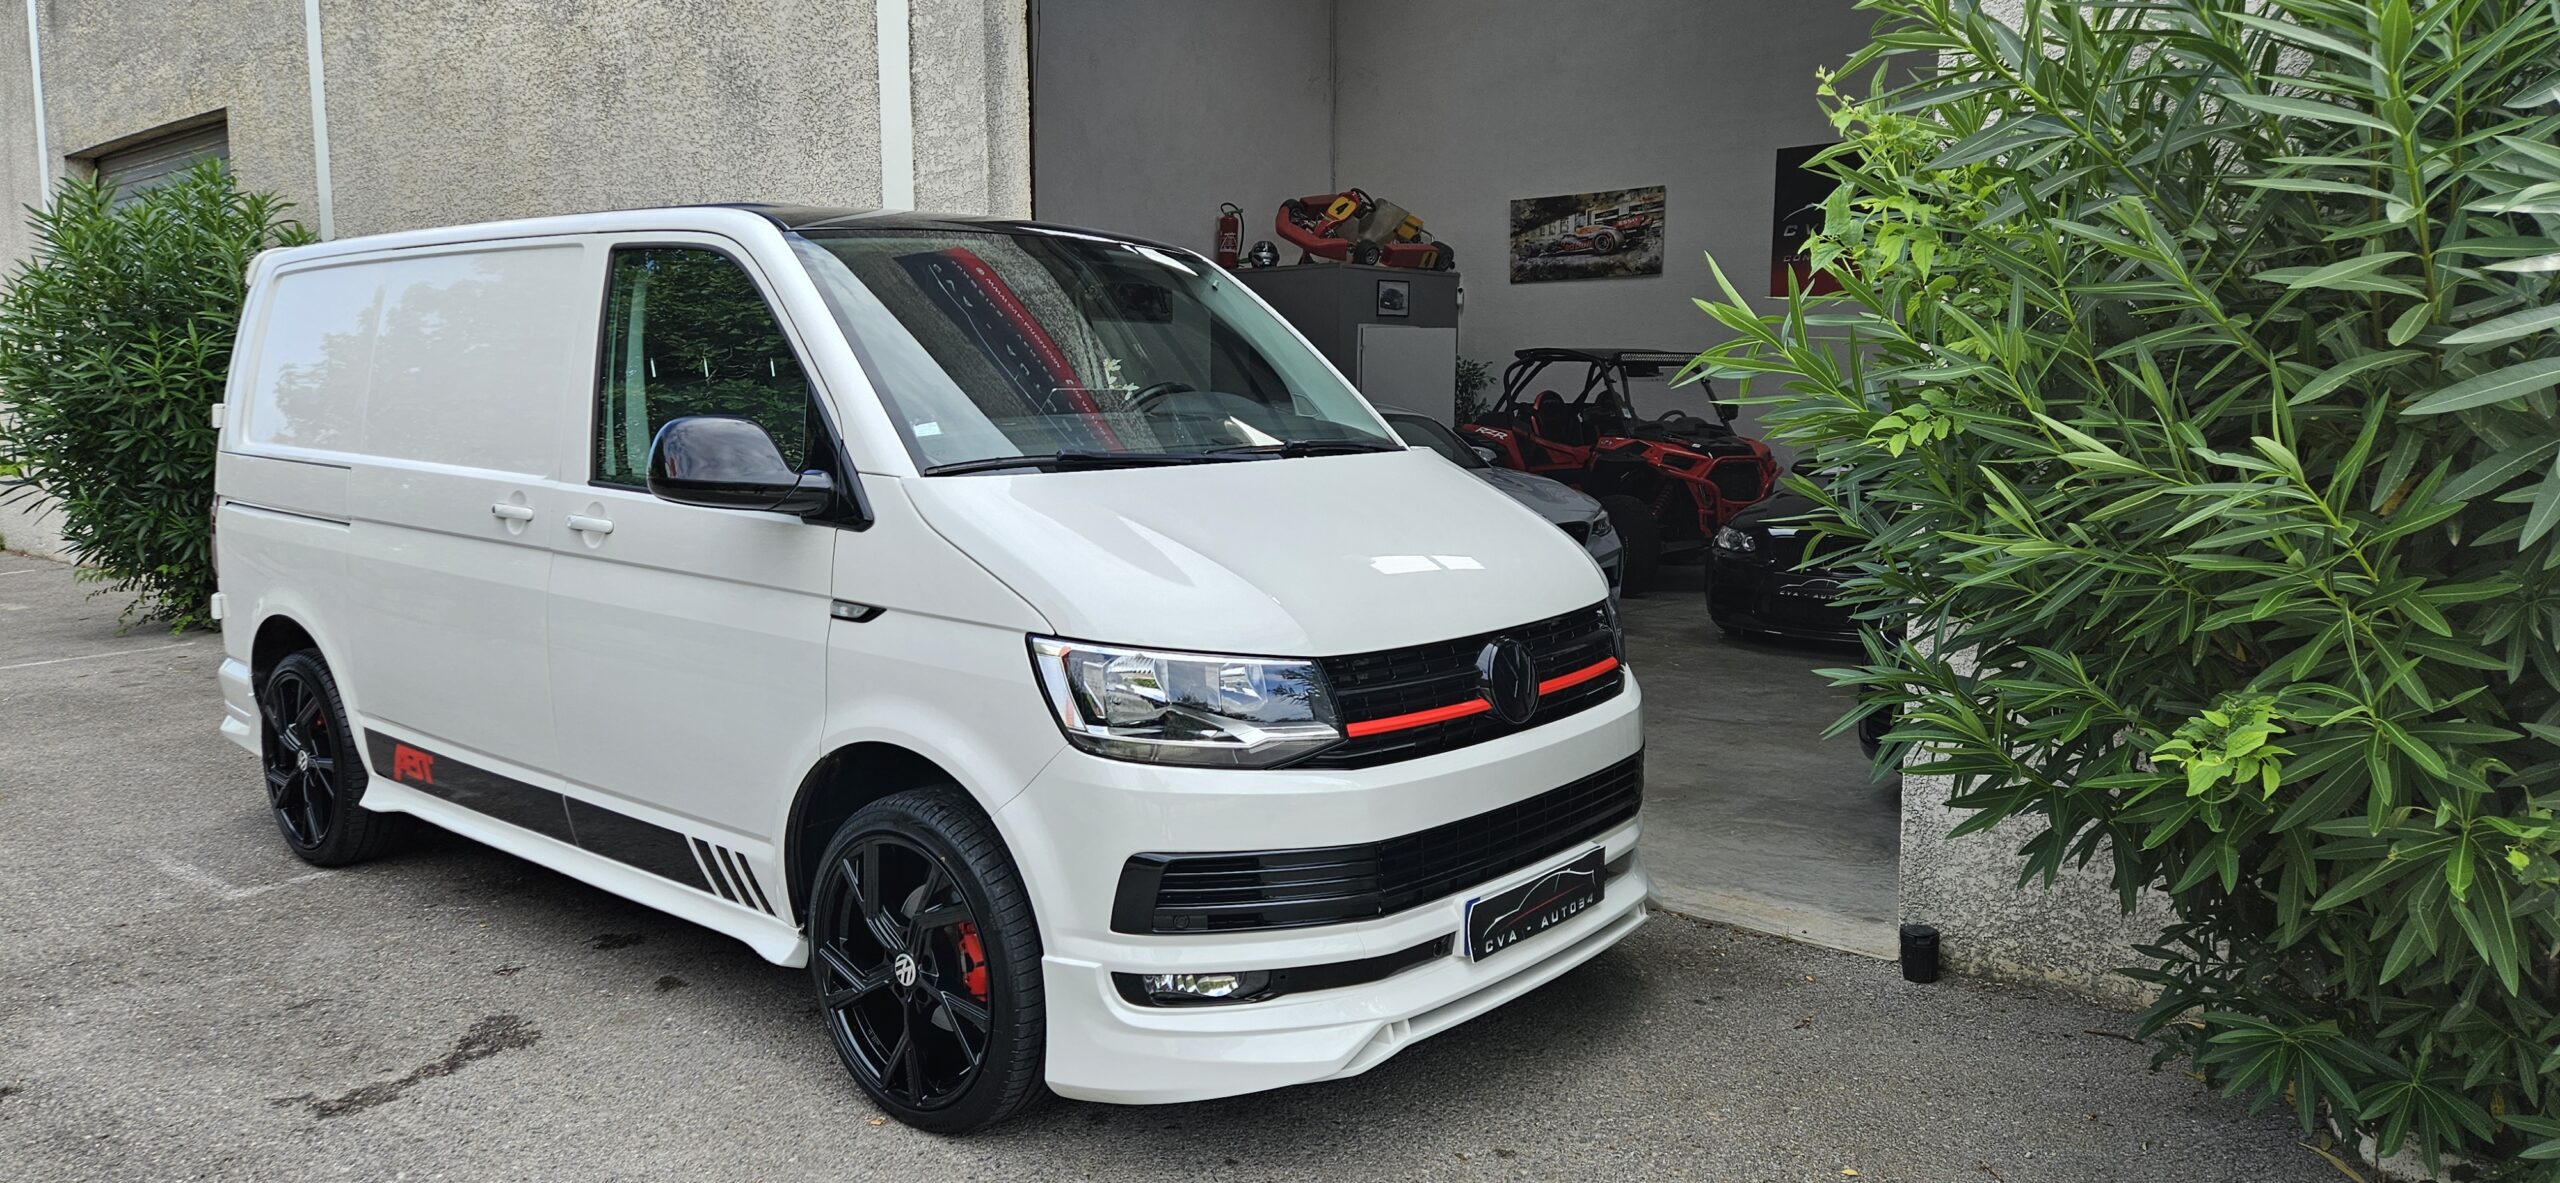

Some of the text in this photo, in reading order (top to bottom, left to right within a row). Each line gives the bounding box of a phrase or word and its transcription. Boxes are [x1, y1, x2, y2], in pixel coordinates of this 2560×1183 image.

[1335, 202, 1350, 215] 4
[393, 743, 434, 784] ABT
[1485, 930, 1517, 953] CVA
[1541, 893, 1594, 929] AUTO34
